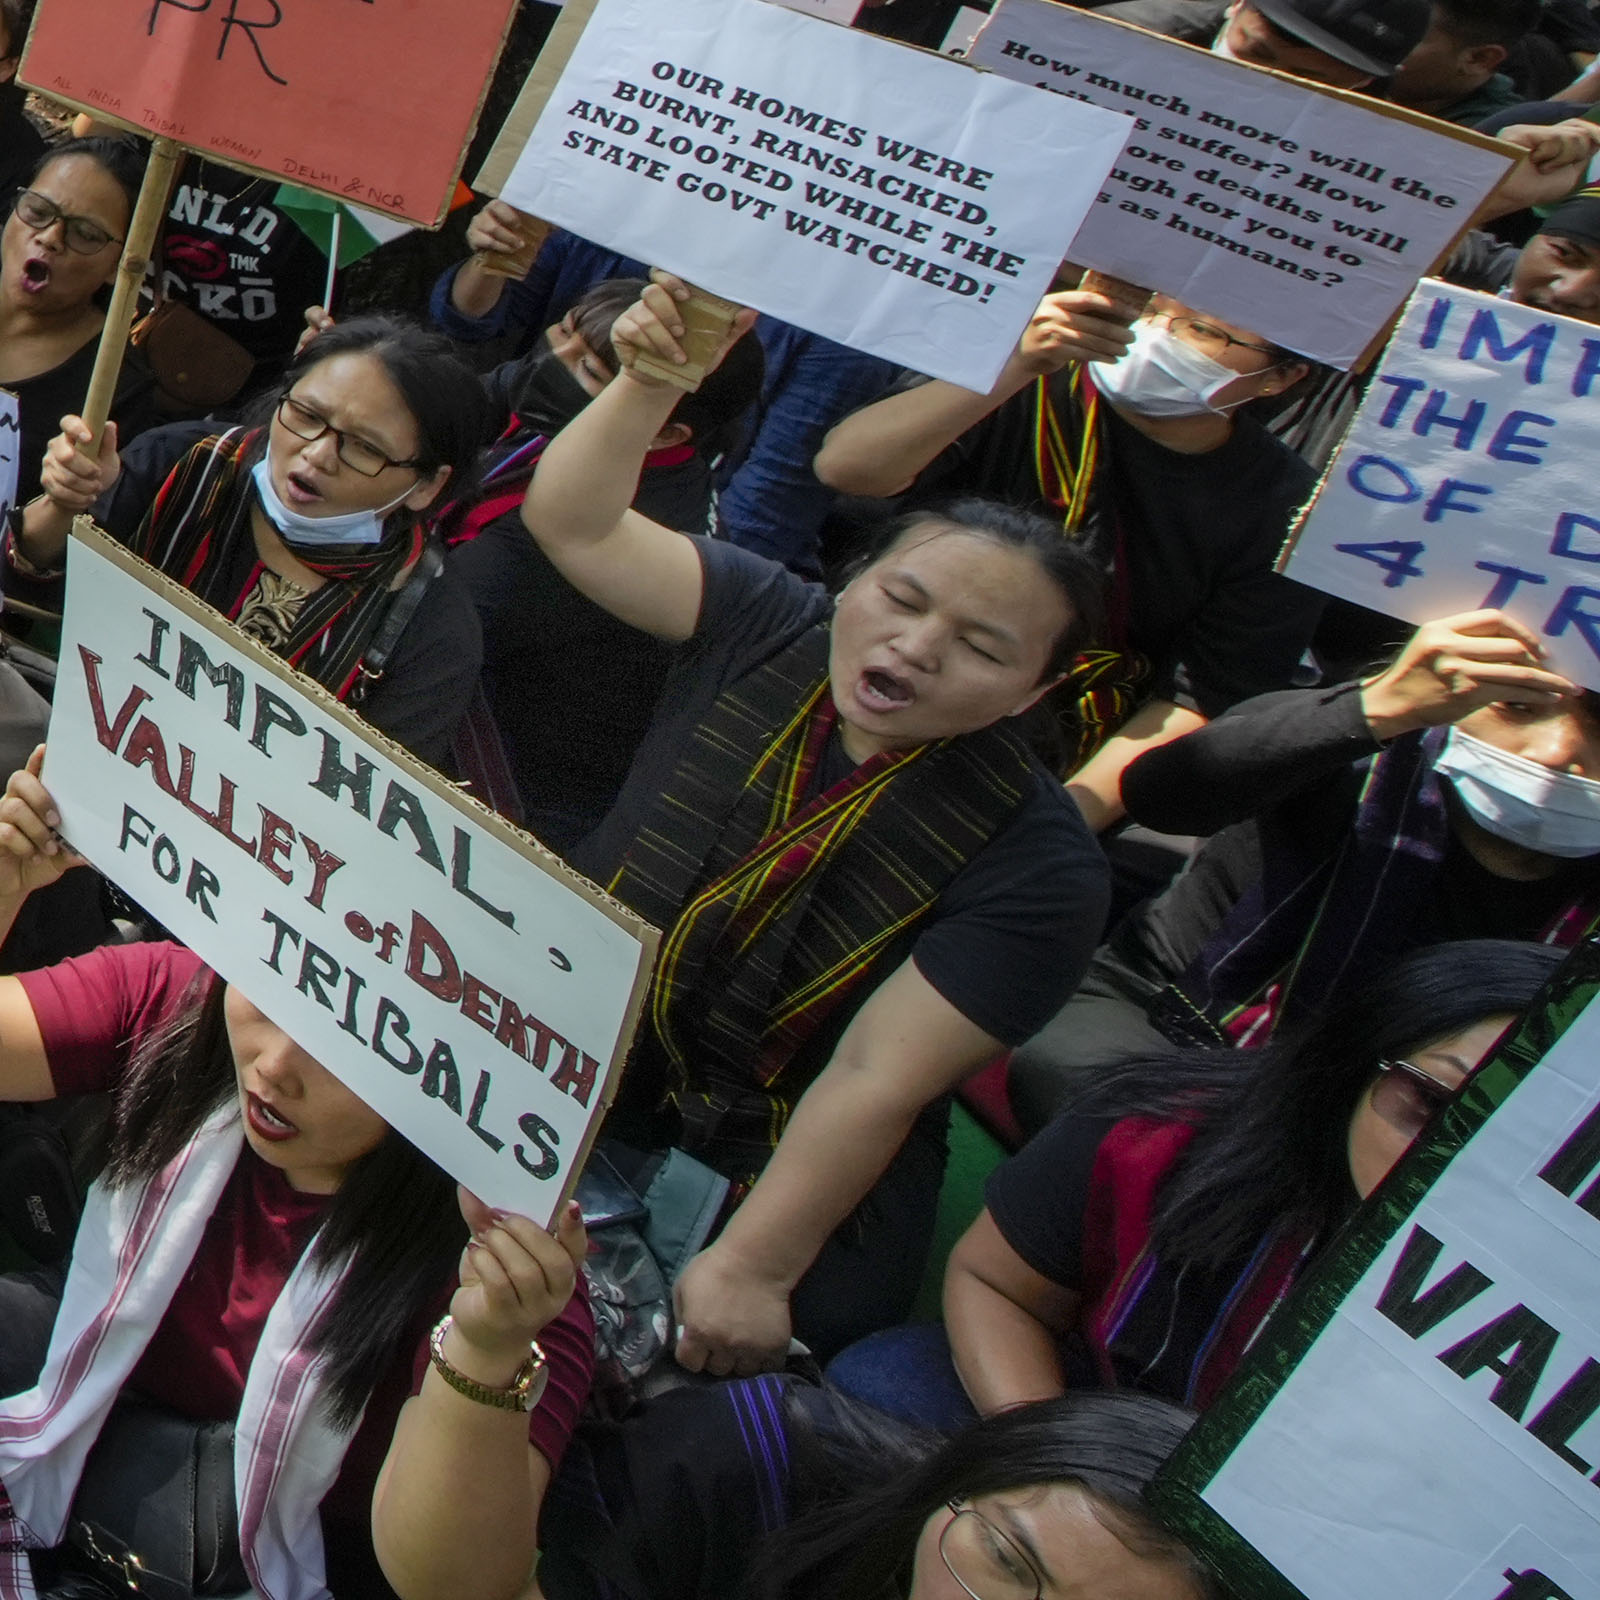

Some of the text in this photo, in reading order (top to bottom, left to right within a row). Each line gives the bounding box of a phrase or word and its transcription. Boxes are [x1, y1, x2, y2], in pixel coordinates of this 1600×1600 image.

[568, 100, 1027, 276] AND LOOTED WHILE THE
[613, 81, 997, 237] BURNT, RANSACKED,
[652, 61, 994, 192] OUR HOMES WERE
[564, 130, 996, 305] STATE GOVT WATCHED!
[76, 643, 600, 1108] VALLEY of DEATH
[118, 803, 560, 1180] FOR TRIBALS
